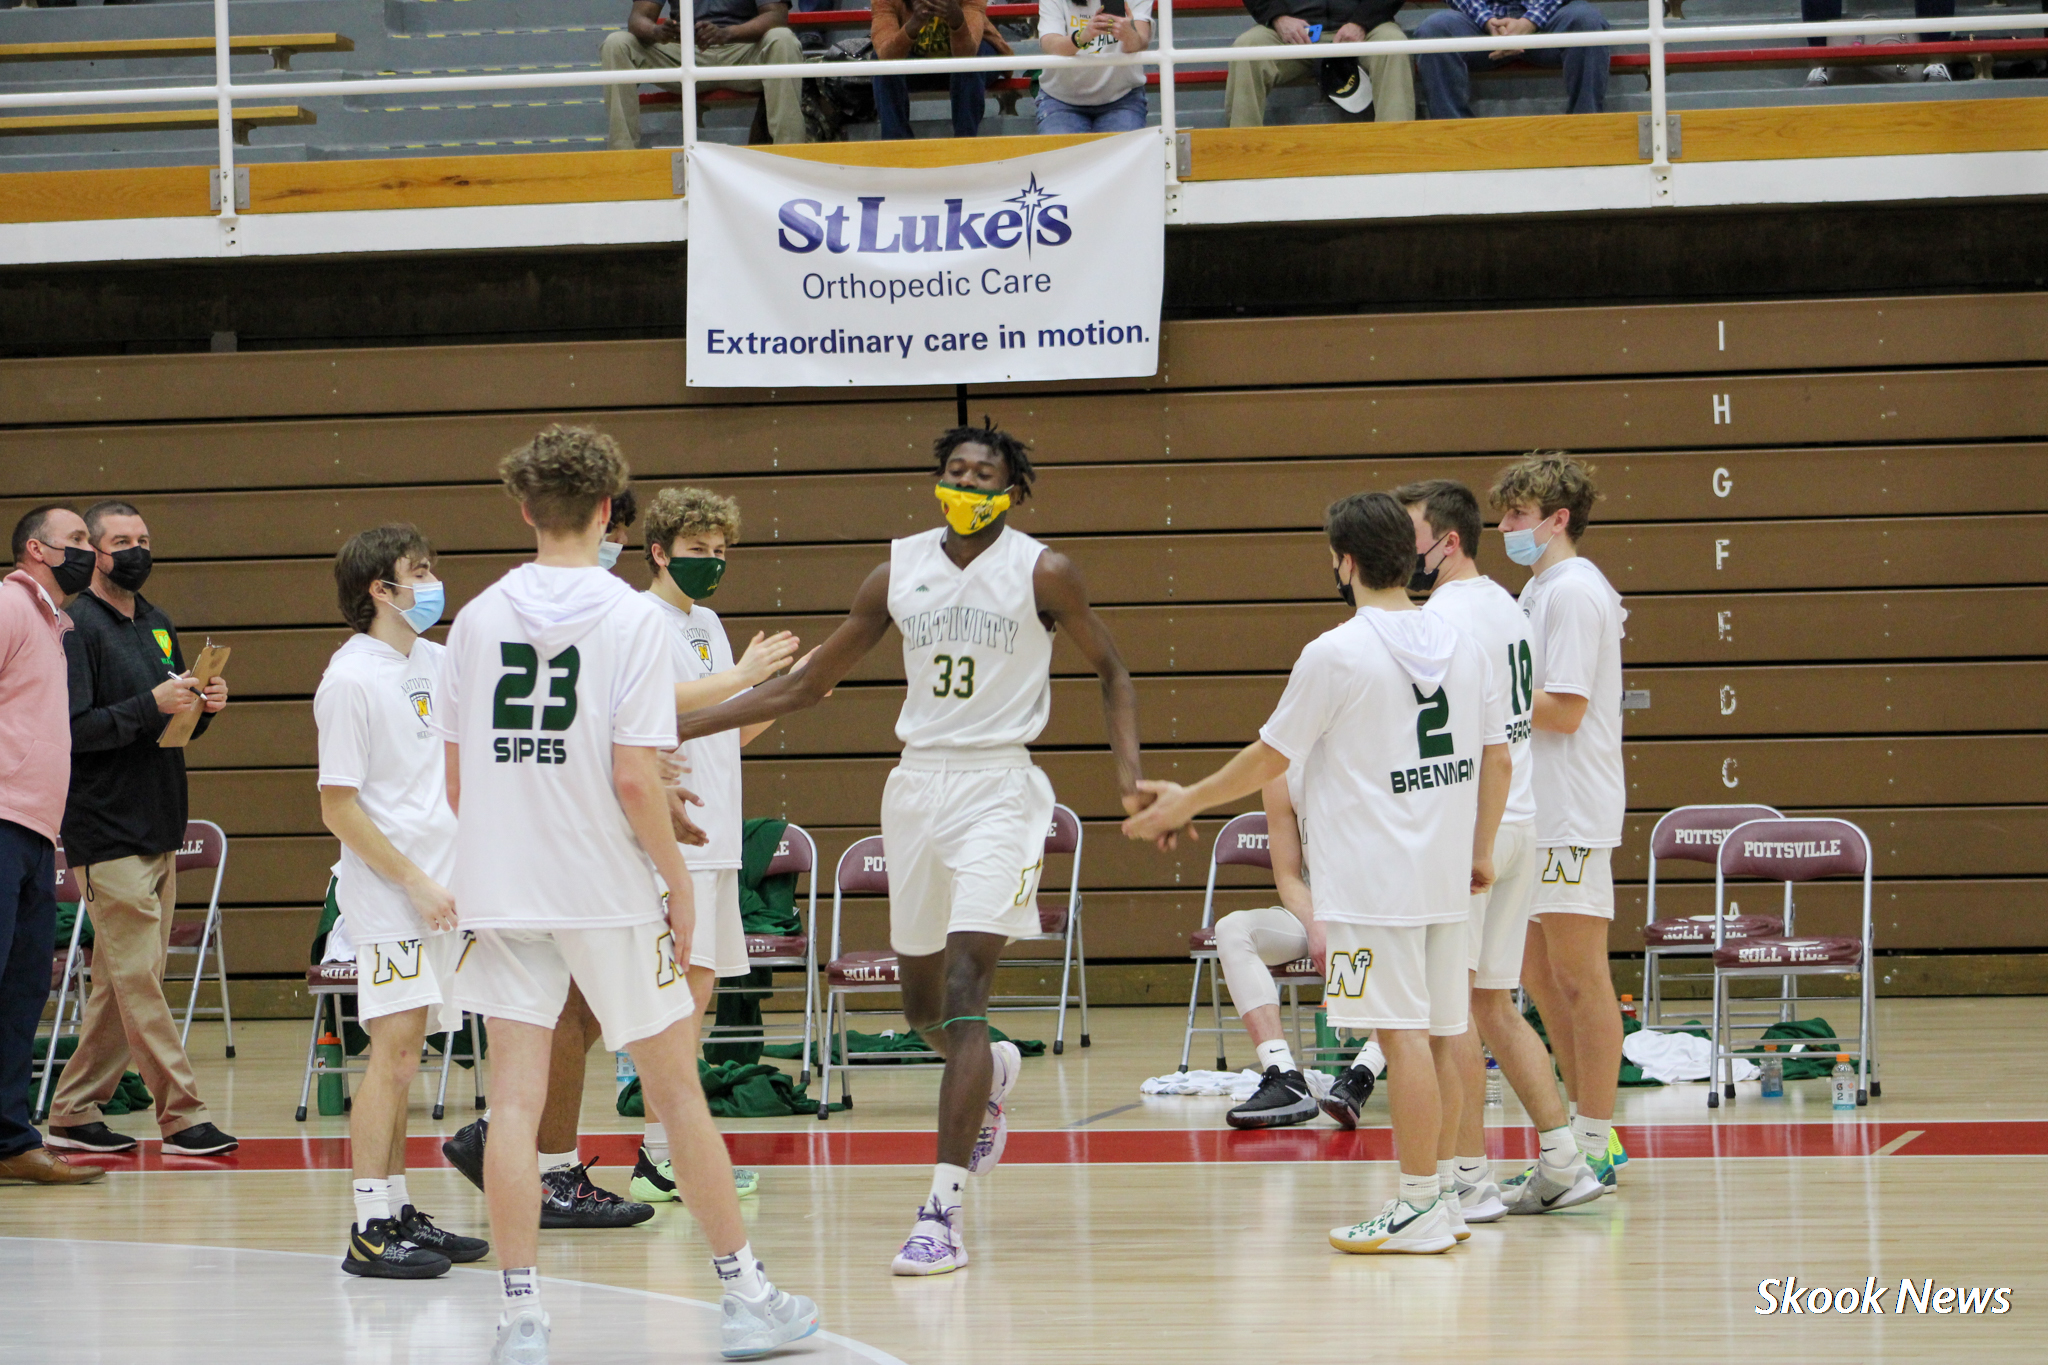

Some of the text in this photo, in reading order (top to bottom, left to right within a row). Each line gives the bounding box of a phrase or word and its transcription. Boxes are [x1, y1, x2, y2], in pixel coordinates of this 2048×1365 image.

[802, 268, 1052, 303] Orthopedic Care
[707, 319, 1150, 359] Extraordinary care in motion.
[1718, 320, 1725, 351] I
[1712, 393, 1731, 425] H
[1712, 467, 1732, 498] G
[1715, 539, 1730, 570] F
[902, 605, 1019, 655] NATIVITY
[492, 641, 581, 731] 23
[932, 653, 975, 699] 33
[1720, 684, 1737, 716] D
[1411, 682, 1455, 760] 2
[493, 737, 568, 765] SIPES
[1390, 757, 1475, 794] BRENNAN
[1721, 758, 1738, 789] C
[1743, 839, 1841, 859] POTTSVILLE
